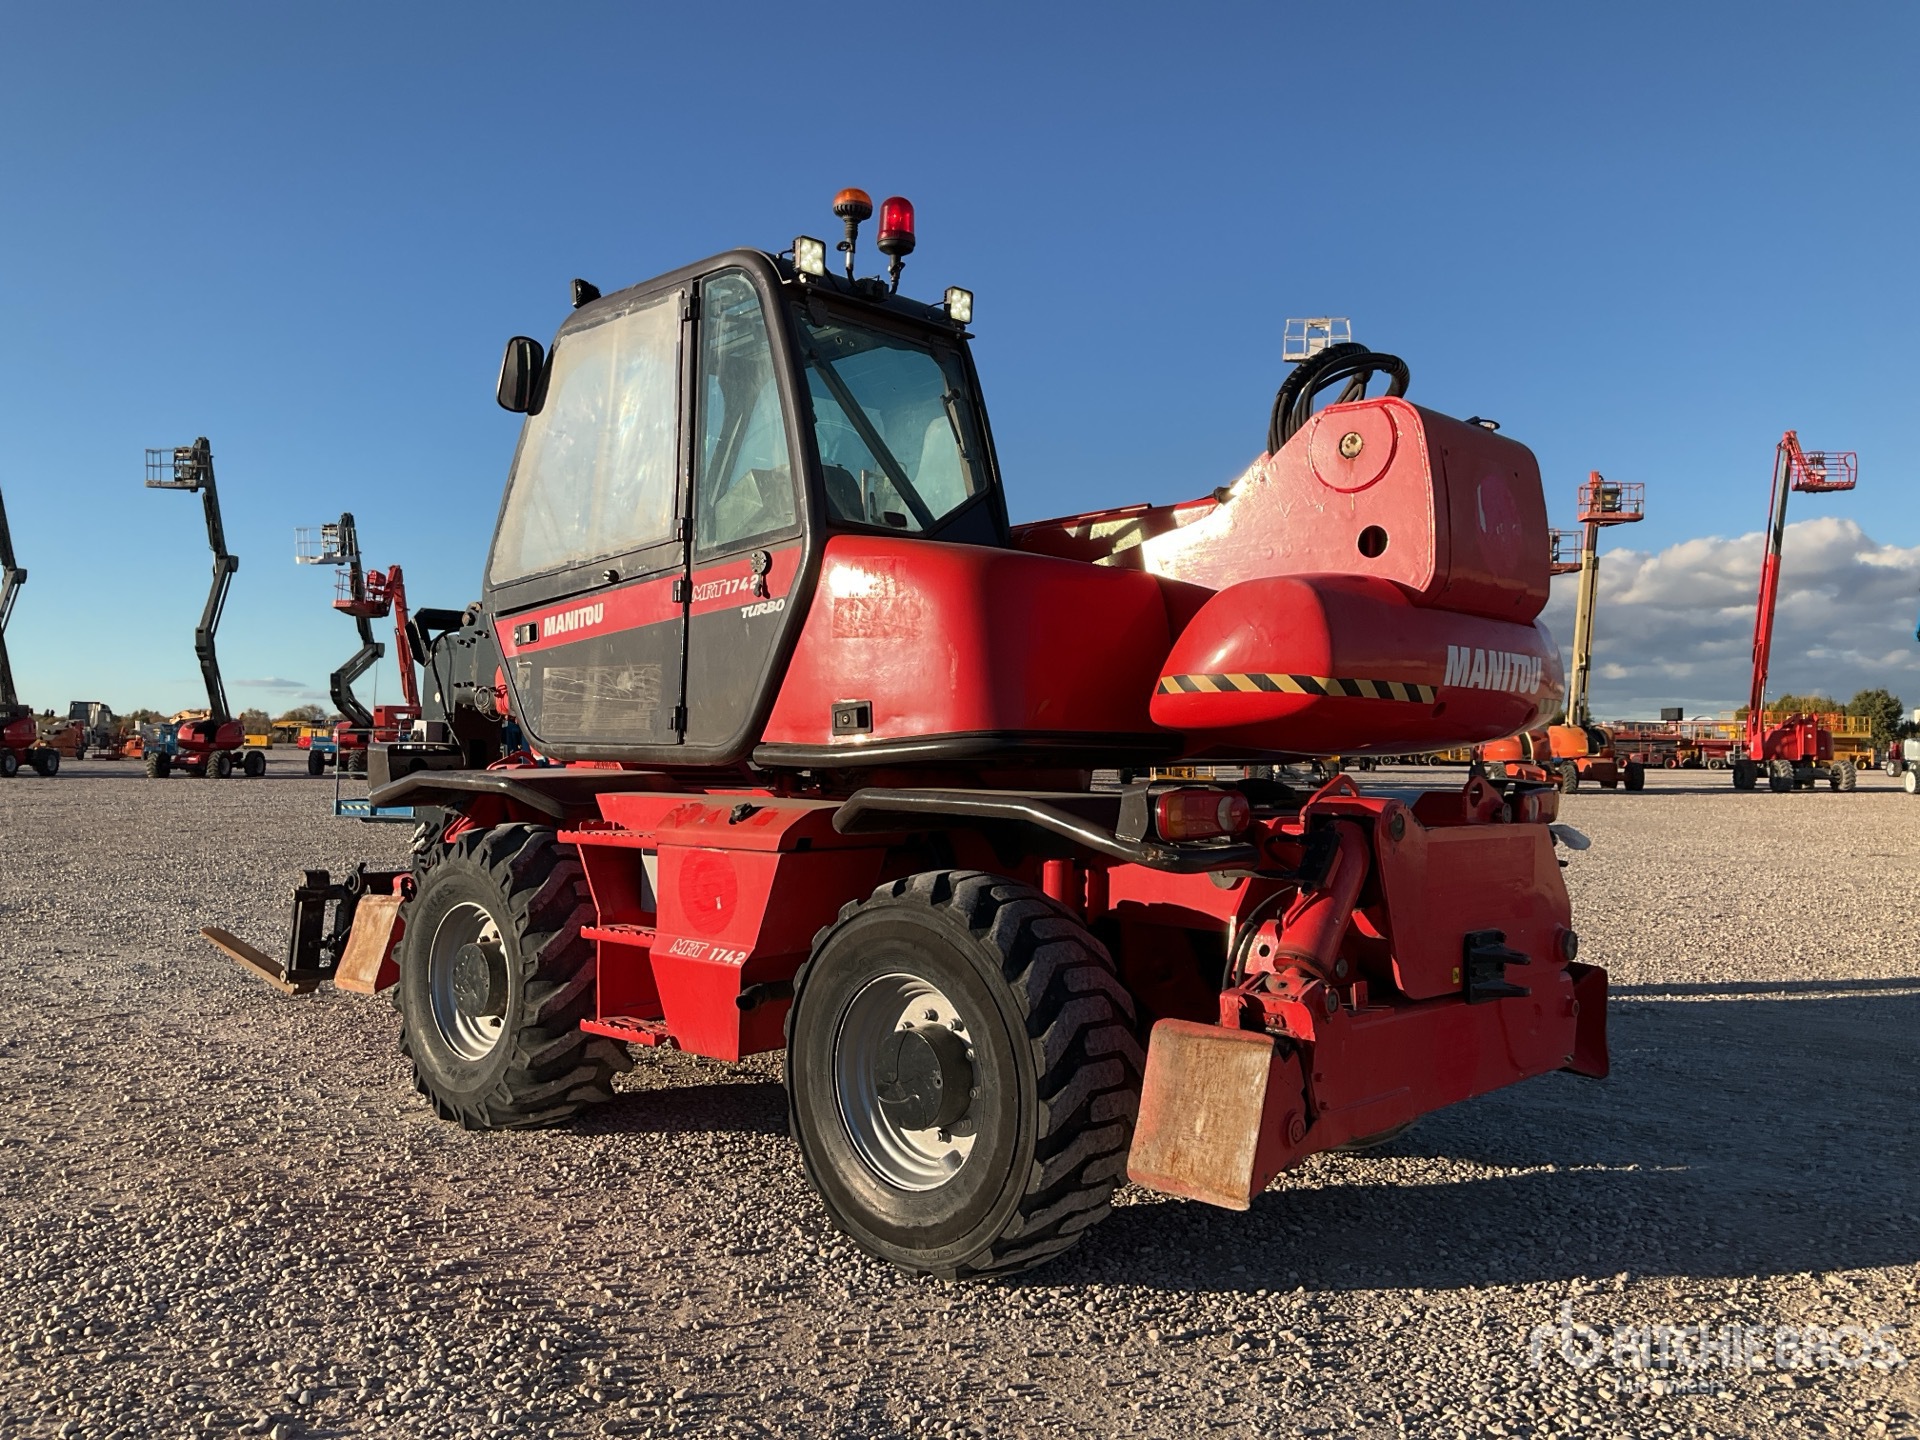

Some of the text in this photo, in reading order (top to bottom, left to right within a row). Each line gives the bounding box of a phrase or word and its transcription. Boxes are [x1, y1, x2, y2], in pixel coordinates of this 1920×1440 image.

[543, 603, 605, 637] MANITOU
[741, 598, 785, 618] TURBO
[1443, 645, 1542, 695] MANITOU
[669, 938, 747, 966] MRT 1742
